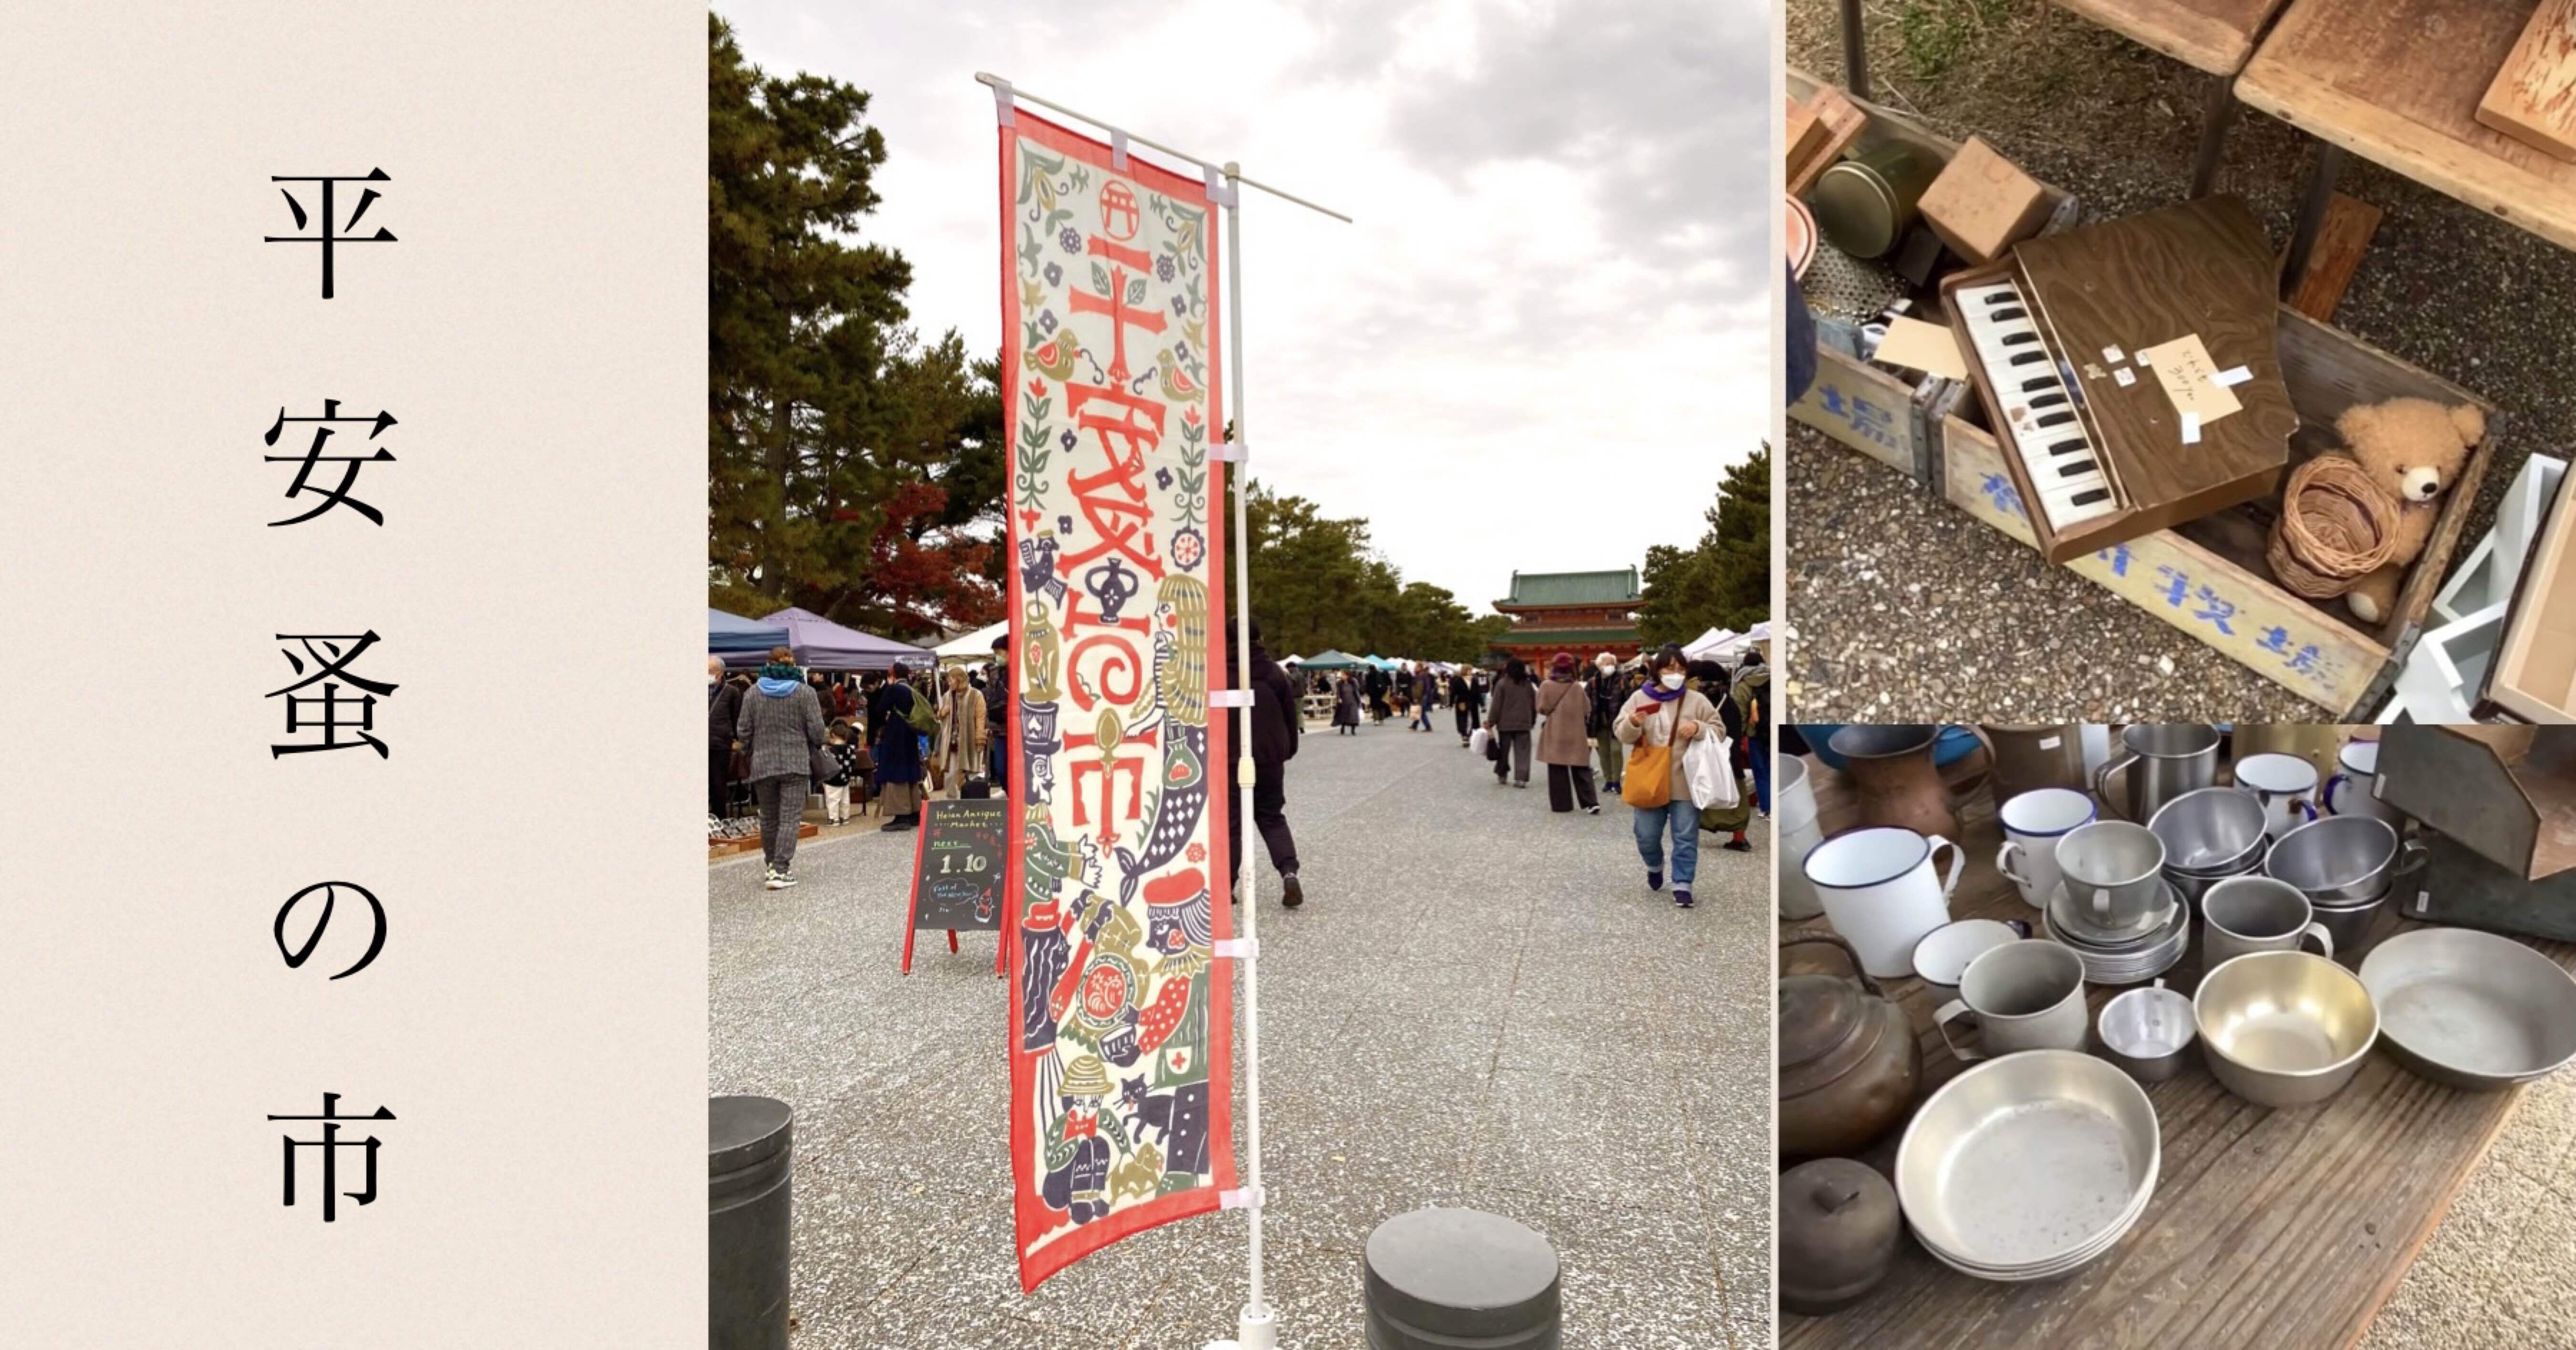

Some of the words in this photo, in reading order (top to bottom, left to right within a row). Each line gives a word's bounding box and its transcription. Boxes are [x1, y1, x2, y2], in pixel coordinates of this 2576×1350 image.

[936, 810, 961, 820] Heian
[963, 809, 1002, 820] Antique
[950, 819, 988, 828] Market
[940, 852, 987, 874] 1.10
